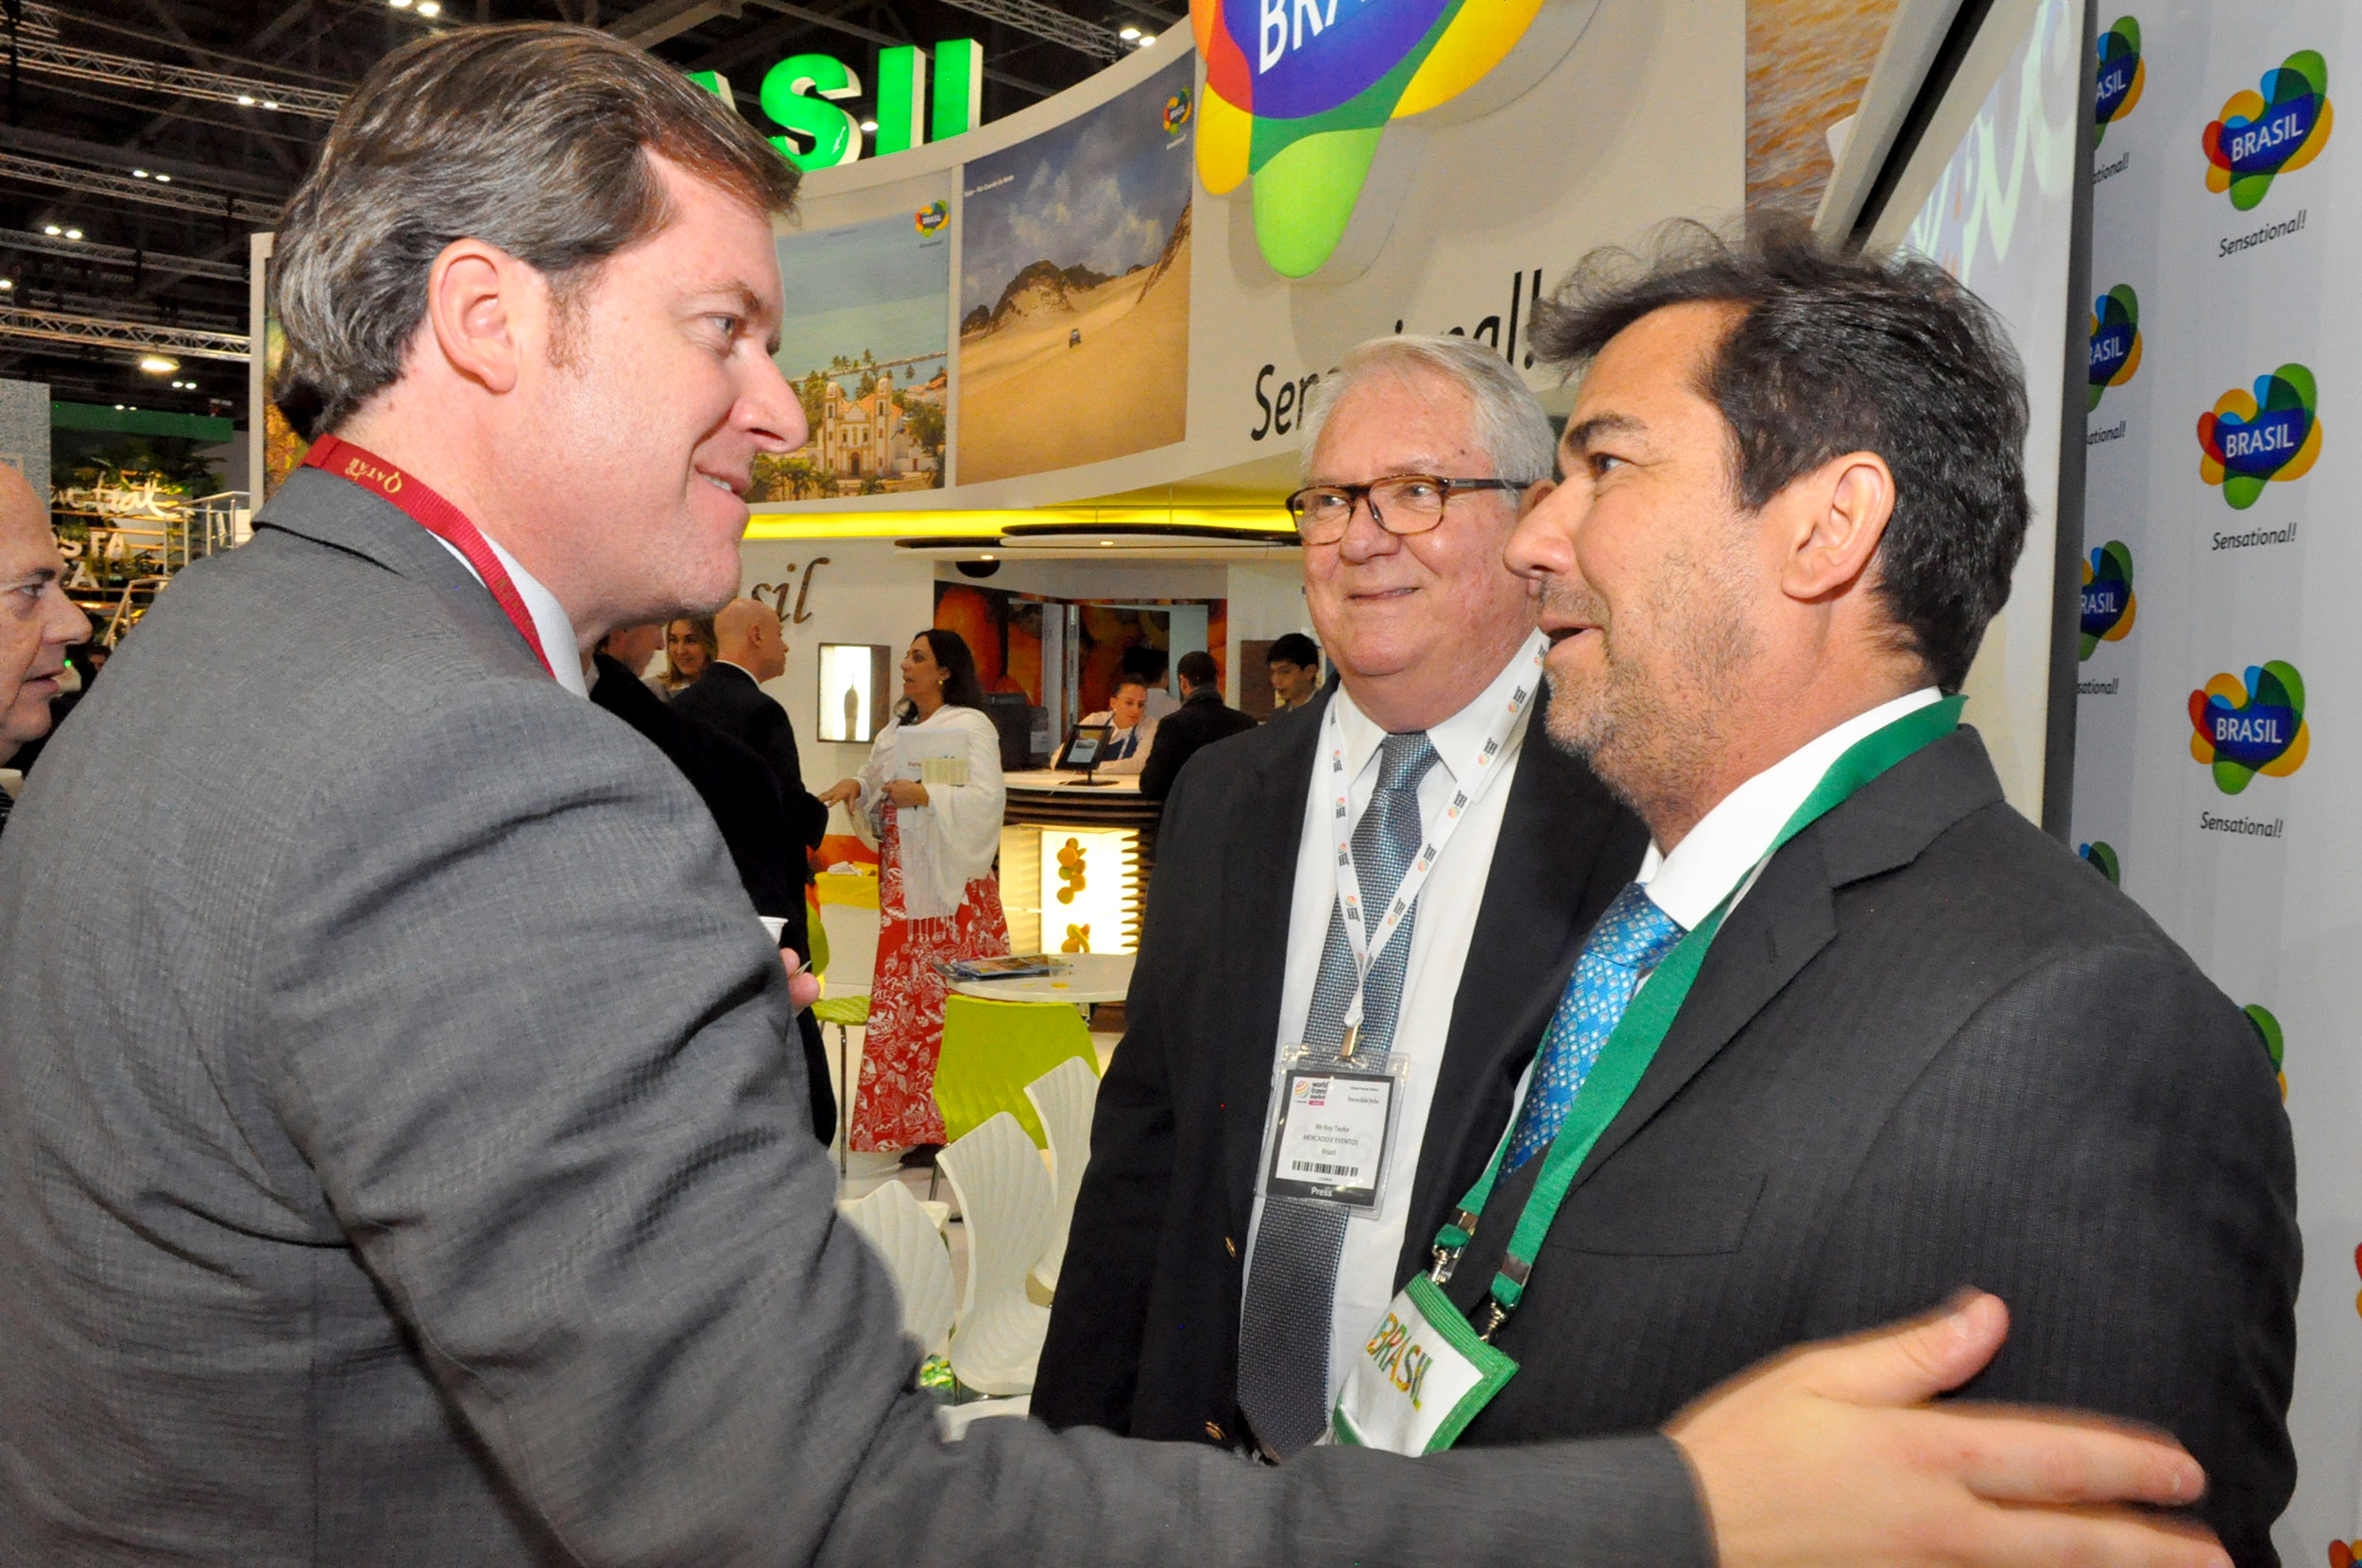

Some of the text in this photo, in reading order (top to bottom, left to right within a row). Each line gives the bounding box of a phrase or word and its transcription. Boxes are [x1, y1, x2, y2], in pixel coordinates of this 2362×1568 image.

[2232, 113, 2303, 162] BRASIL
[2218, 210, 2307, 258] Sensational!
[2226, 424, 2294, 458] BRASIL
[2212, 522, 2297, 551] Sensational!
[2216, 717, 2283, 743] BRASIL
[2200, 811, 2284, 838] Sensational!
[1310, 1185, 1333, 1198] Press
[1366, 1312, 1433, 1411] BRASIL
